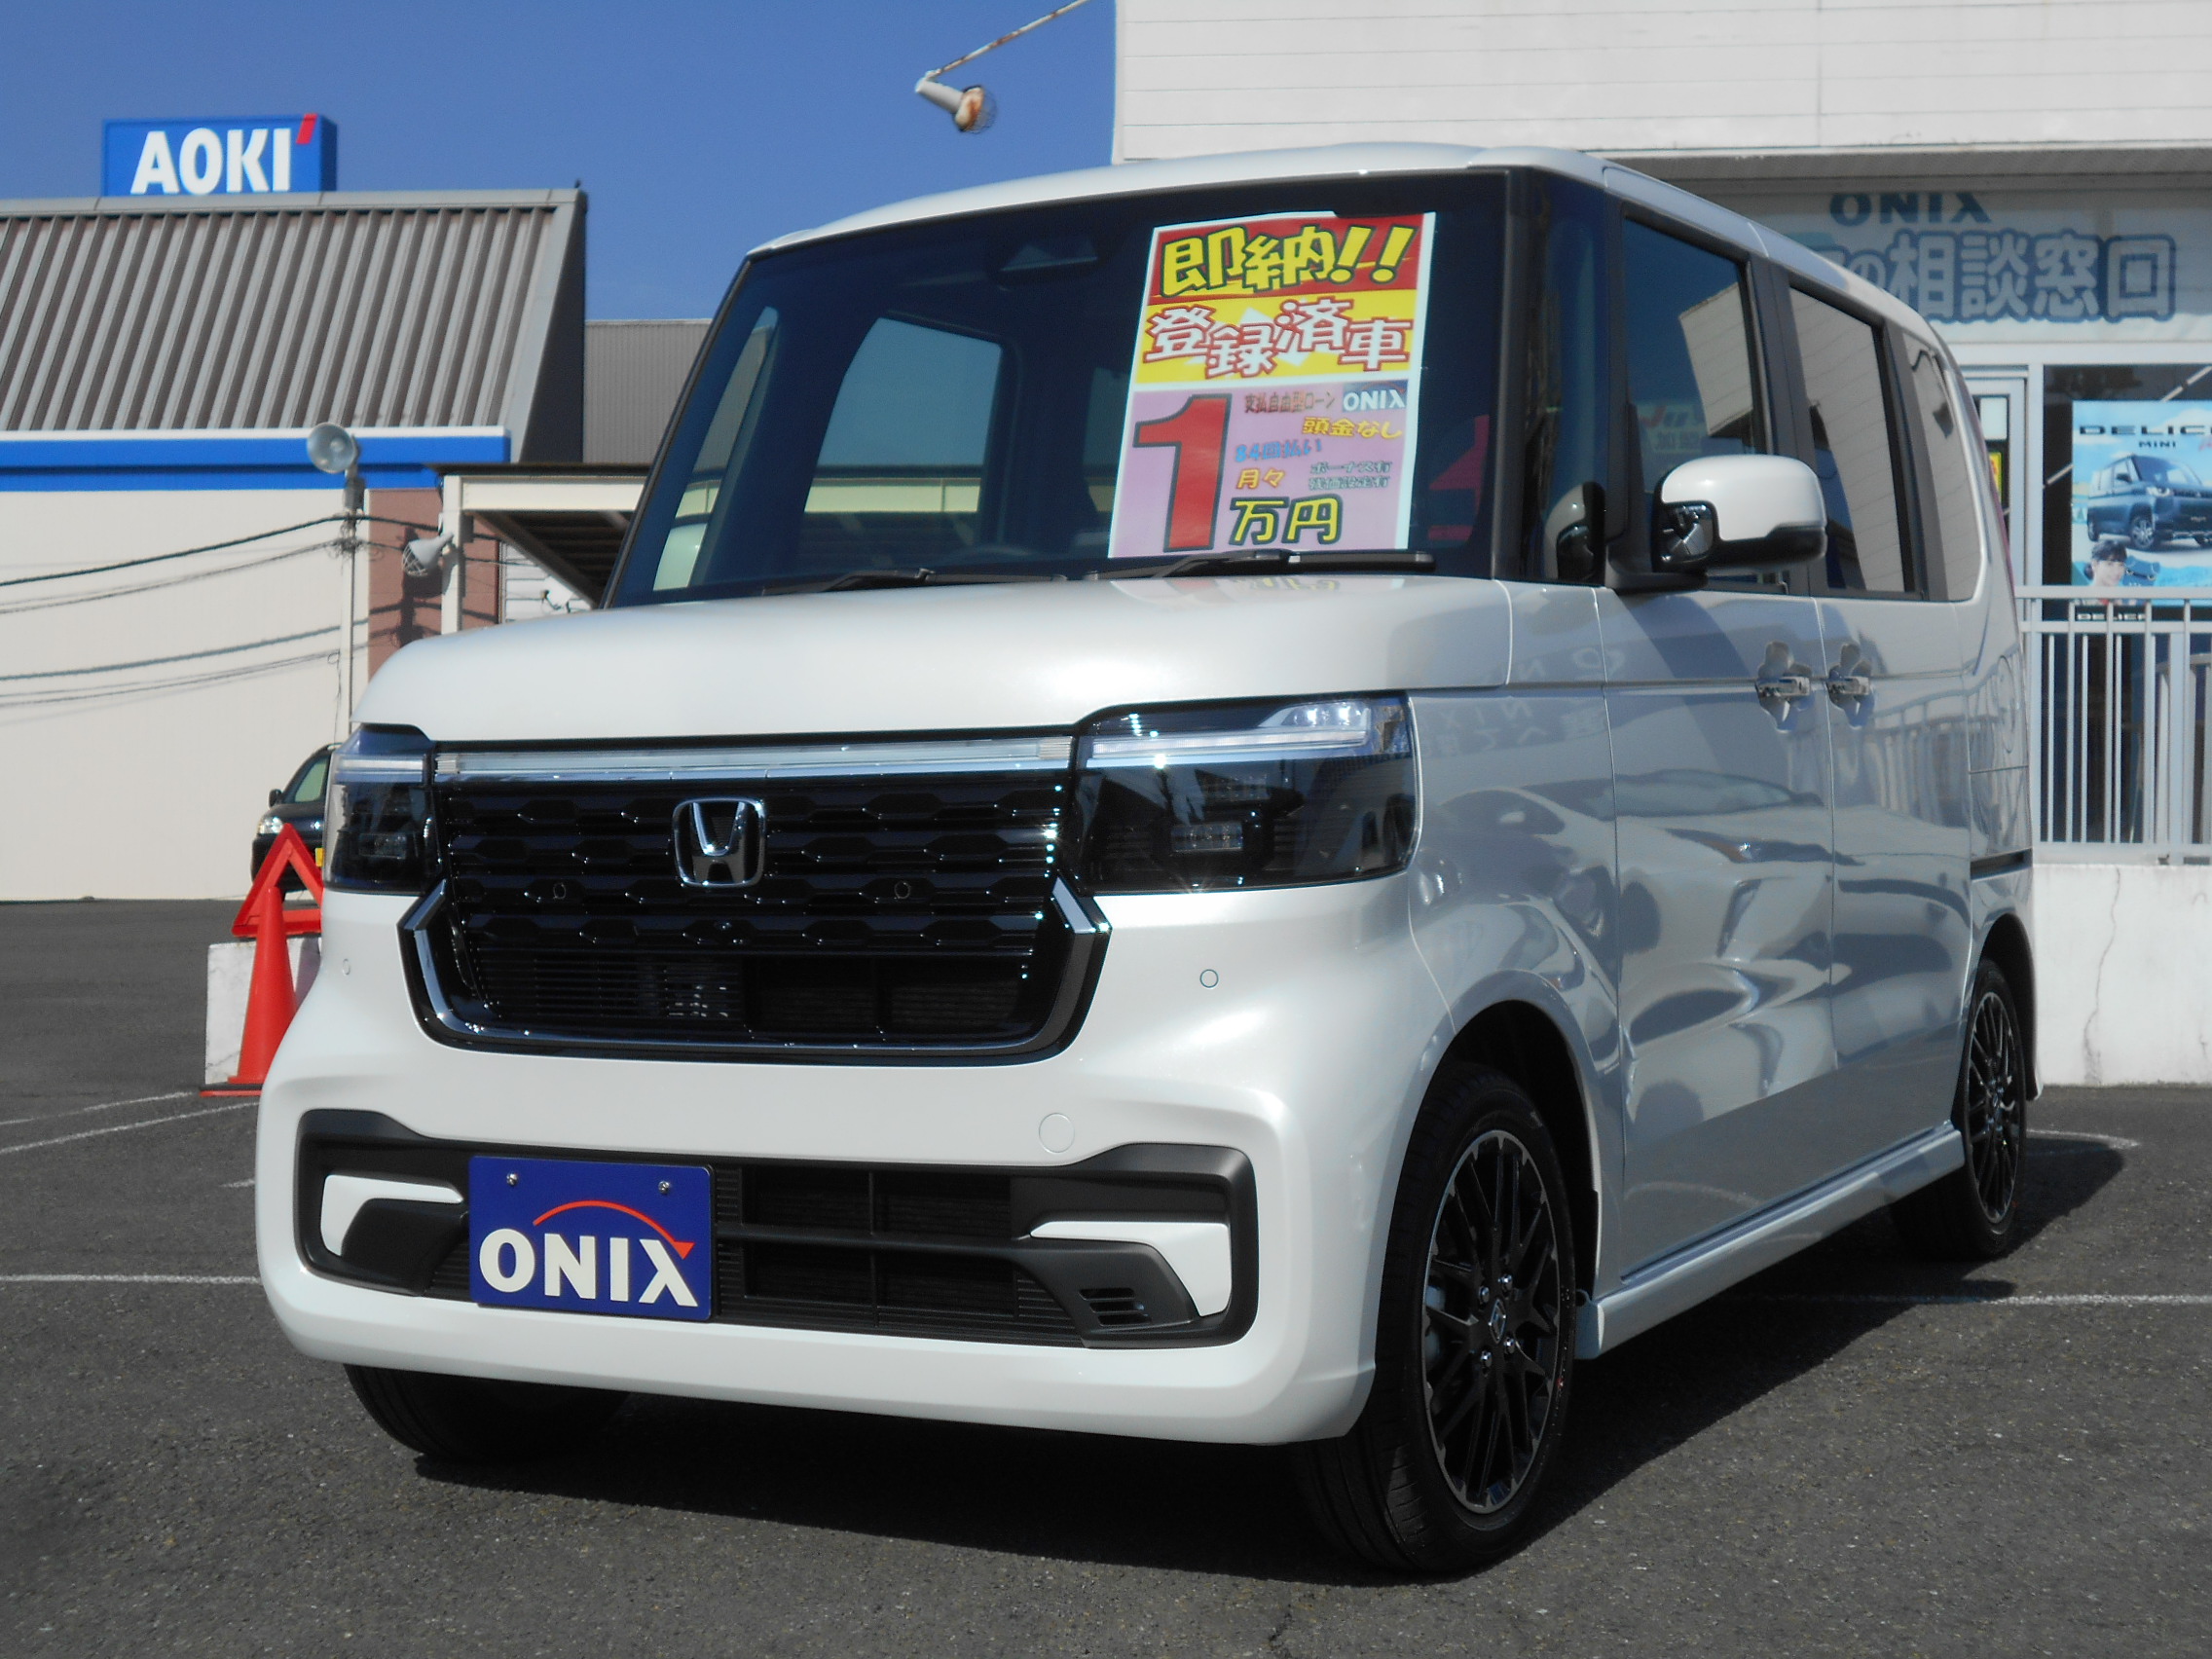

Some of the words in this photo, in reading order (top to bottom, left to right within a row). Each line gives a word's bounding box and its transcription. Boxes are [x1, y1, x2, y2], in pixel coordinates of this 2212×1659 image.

[129, 127, 292, 195] AOKI
[1829, 193, 1992, 227] ONIX
[1160, 224, 1419, 298] 即納!!
[1813, 228, 2177, 324] の相談窓口
[1142, 296, 1414, 380] 登録済車
[1343, 388, 1406, 412] ONIX
[1301, 416, 1403, 439] 頭金なし
[2080, 424, 2212, 435] DELIC
[2138, 440, 2177, 449] MINI
[1235, 438, 1323, 463] 84回払い
[1235, 467, 1286, 490] 月々
[1229, 493, 1344, 547] 万円
[479, 1228, 699, 1308] ONIX
